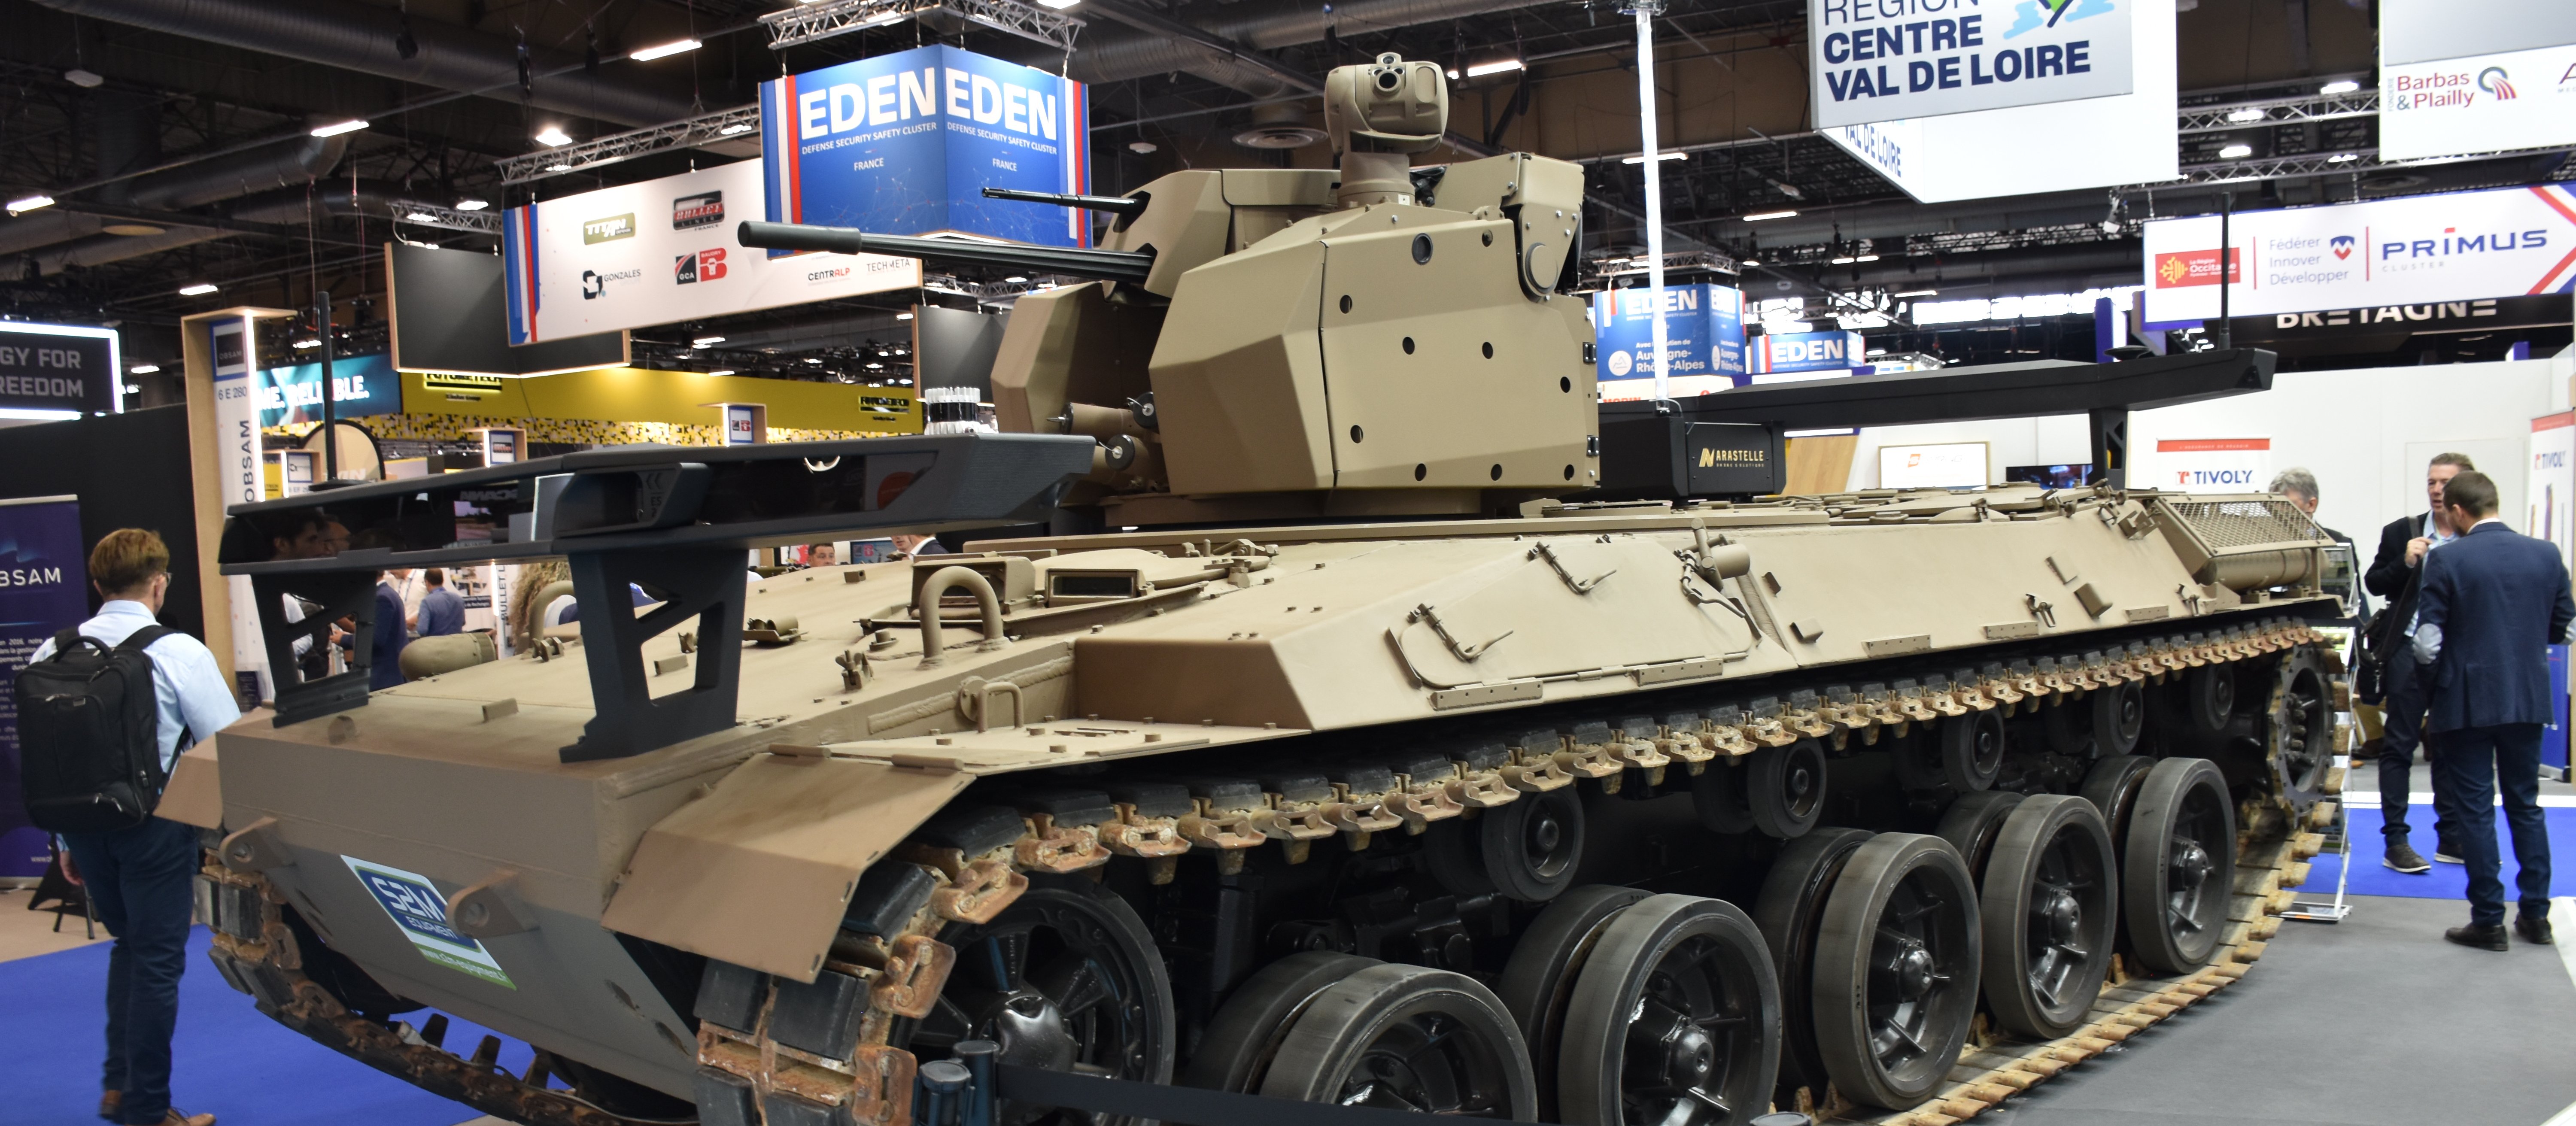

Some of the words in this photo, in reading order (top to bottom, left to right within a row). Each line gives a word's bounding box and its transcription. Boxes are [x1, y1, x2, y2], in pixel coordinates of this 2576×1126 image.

[1824, 15, 1983, 64] CENTRE
[1825, 66, 1900, 101] VAL
[1909, 57, 1962, 93] DE
[1971, 40, 2091, 86] LOIRE
[2397, 72, 2470, 91] Barbas
[800, 67, 936, 140] EDEN
[946, 67, 1057, 141] EDEN
[2397, 95, 2411, 111] &
[2414, 89, 2475, 108] Plailly
[802, 141, 834, 155] DEFENSE
[835, 134, 872, 148] SECURITY
[873, 128, 901, 141] SAFETY
[902, 122, 937, 135] CLUSTER
[947, 122, 976, 136] DEFENSE
[977, 128, 1007, 143] SECURITY
[1008, 136, 1030, 149] SAFETY
[1031, 142, 1057, 155] CLUSTER
[1864, 124, 1875, 159] DE
[1877, 131, 1901, 178] LOIRE
[854, 158, 884, 171] FRANCE
[992, 158, 1018, 172] FRANCE
[676, 205, 720, 220] BULLET
[585, 218, 626, 237] TITAN
[681, 216, 715, 227] LINER
[2270, 237, 2321, 250] Fédérer
[2190, 263, 2236, 273] Occitae
[2270, 256, 2321, 267] Innover
[2382, 261, 2445, 273] CLUSTER
[604, 269, 641, 282] GONZALES
[679, 272, 695, 281] GCA
[808, 267, 851, 281] CENTRALP
[2270, 270, 2349, 285] Développer
[0, 346, 30, 366] GY
[38, 348, 82, 369] FOR
[219, 350, 242, 359] OBSAM
[1636, 349, 1692, 361] Auvgne-
[1771, 339, 1843, 363] EDEN
[1636, 360, 1704, 373] Rhô-Alpes
[218, 390, 224, 400] 6
[225, 388, 231, 399] E
[234, 386, 247, 398] 280
[286, 375, 370, 406] RELIBLE.
[240, 420, 255, 502] OBSAM
[1716, 450, 1764, 461] ARASTELLE
[2194, 470, 2253, 484] TIVOLY
[498, 576, 508, 621] BULLET
[371, 877, 446, 922] S2M
[405, 915, 459, 940] EQUIPMENT
